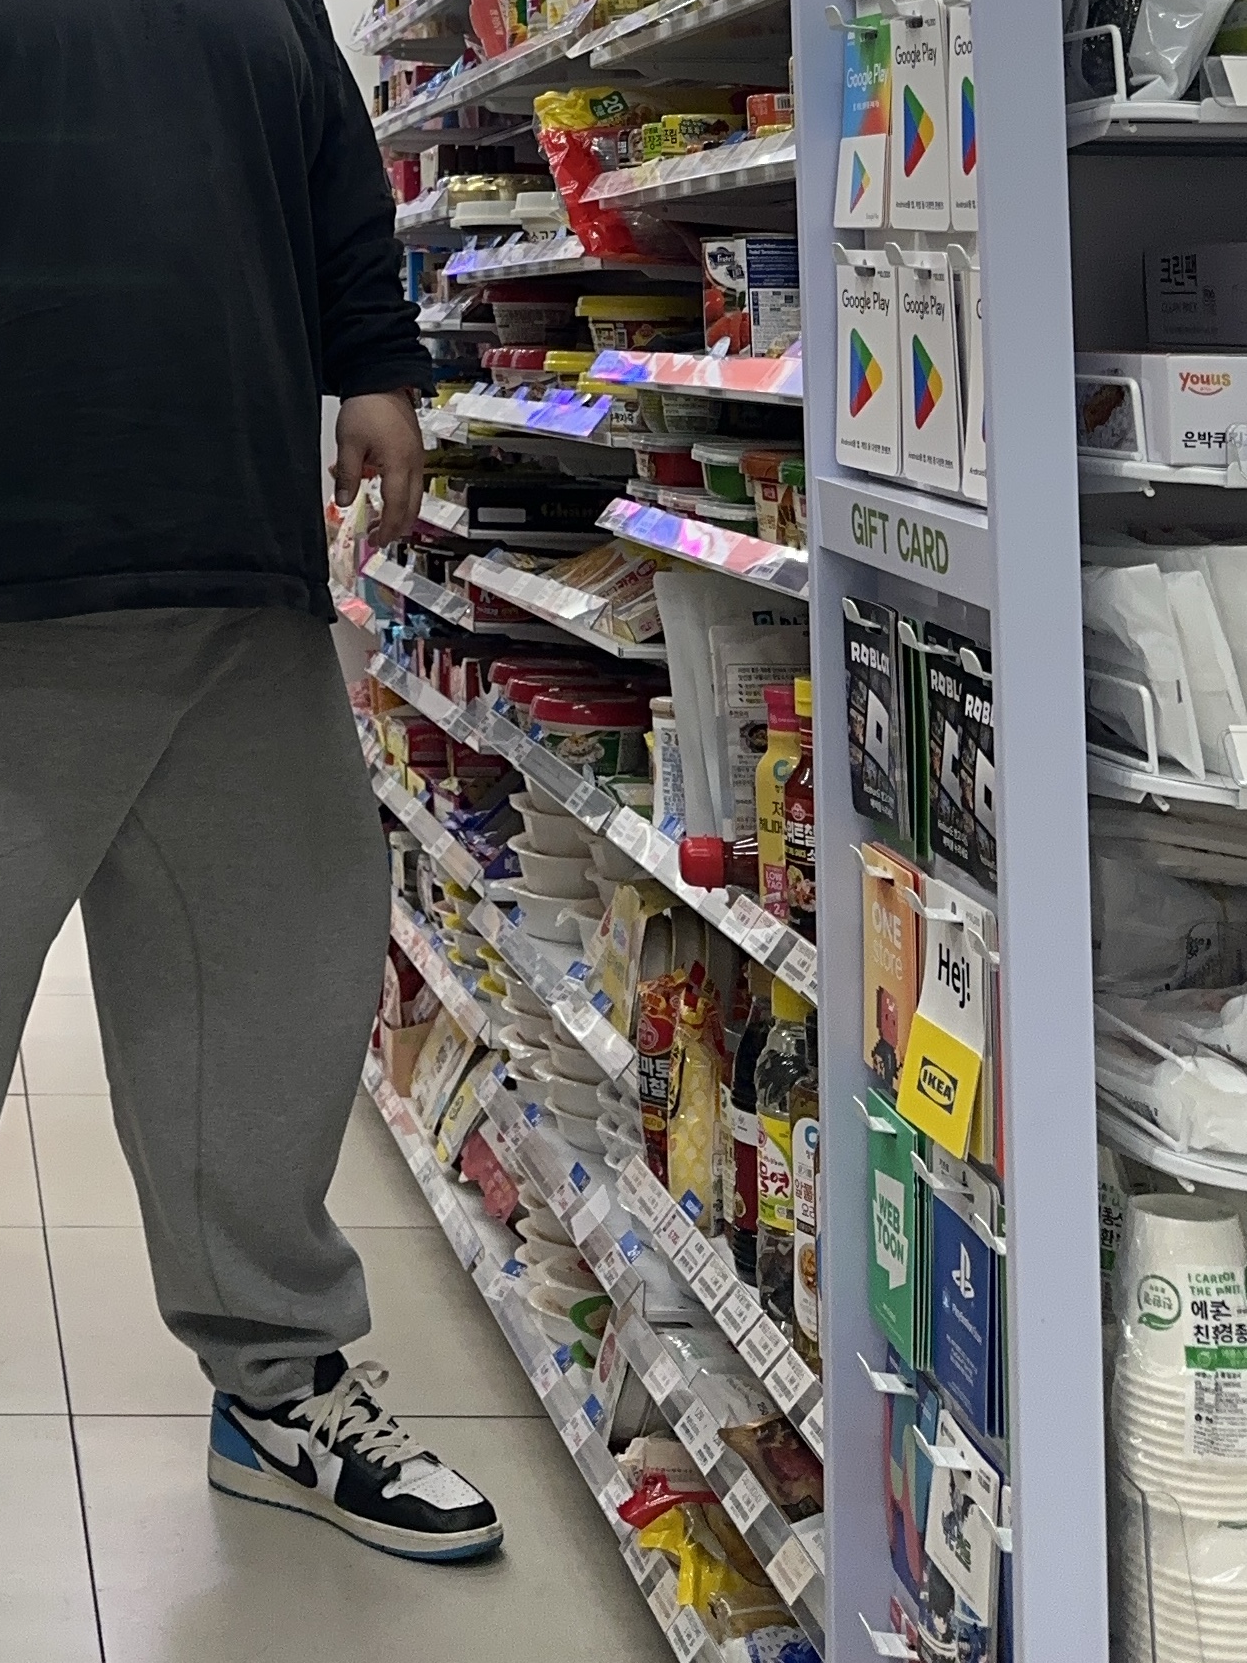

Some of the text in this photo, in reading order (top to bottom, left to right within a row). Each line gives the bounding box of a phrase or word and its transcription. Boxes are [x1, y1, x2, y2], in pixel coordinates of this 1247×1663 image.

[895, 43, 938, 69] Google Play
[846, 63, 888, 93] Google Play
[1160, 253, 1198, 287] 크린팩
[841, 288, 891, 317] Google Play
[903, 292, 946, 322] Google Play
[1178, 371, 1232, 393] youus
[852, 501, 950, 576] GIFT CARD
[871, 900, 903, 951] ONE
[872, 937, 904, 981] store
[937, 941, 972, 1010] Hej!
[921, 1068, 955, 1103] IKEA
[877, 1192, 901, 1236] WEB
[876, 1216, 905, 1266] TOON
[1189, 1285, 1215, 1297] THE
